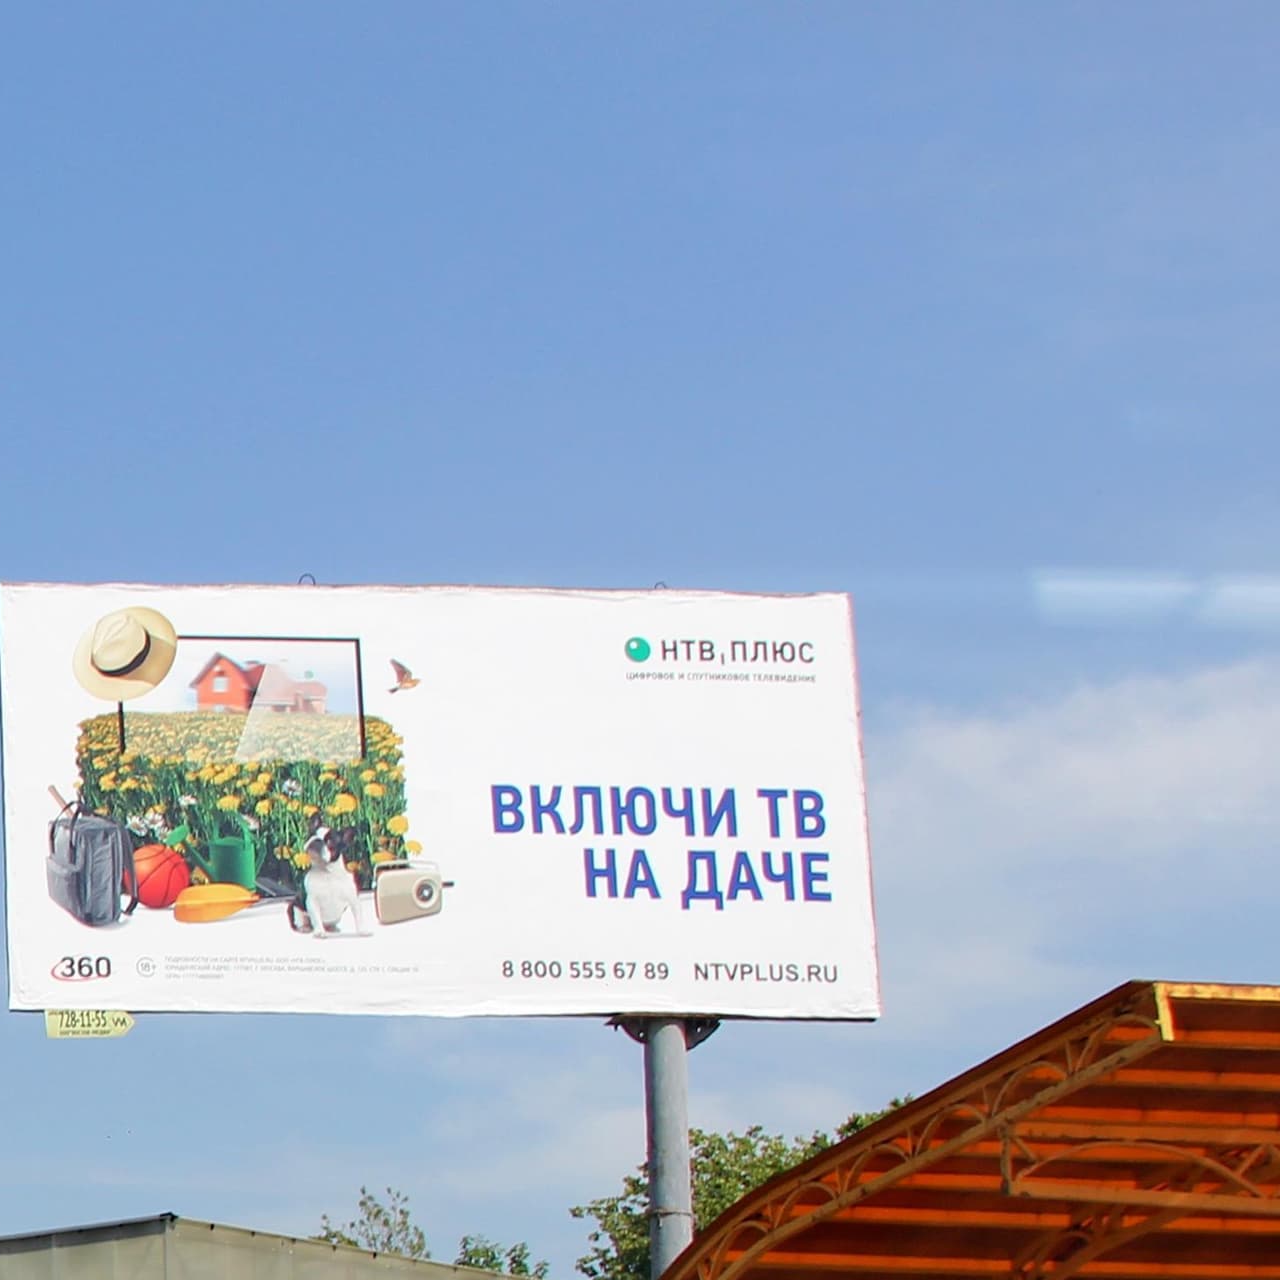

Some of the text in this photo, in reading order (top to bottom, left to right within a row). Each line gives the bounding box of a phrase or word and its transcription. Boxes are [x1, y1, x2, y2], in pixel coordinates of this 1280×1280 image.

[491, 784, 827, 839] ВКЛЮЧИ ТВ
[583, 848, 833, 911] НА ДАЧЕ
[60, 955, 112, 979] 360
[502, 960, 838, 983] 8 800 555 67 89 NTVPLUS.RU
